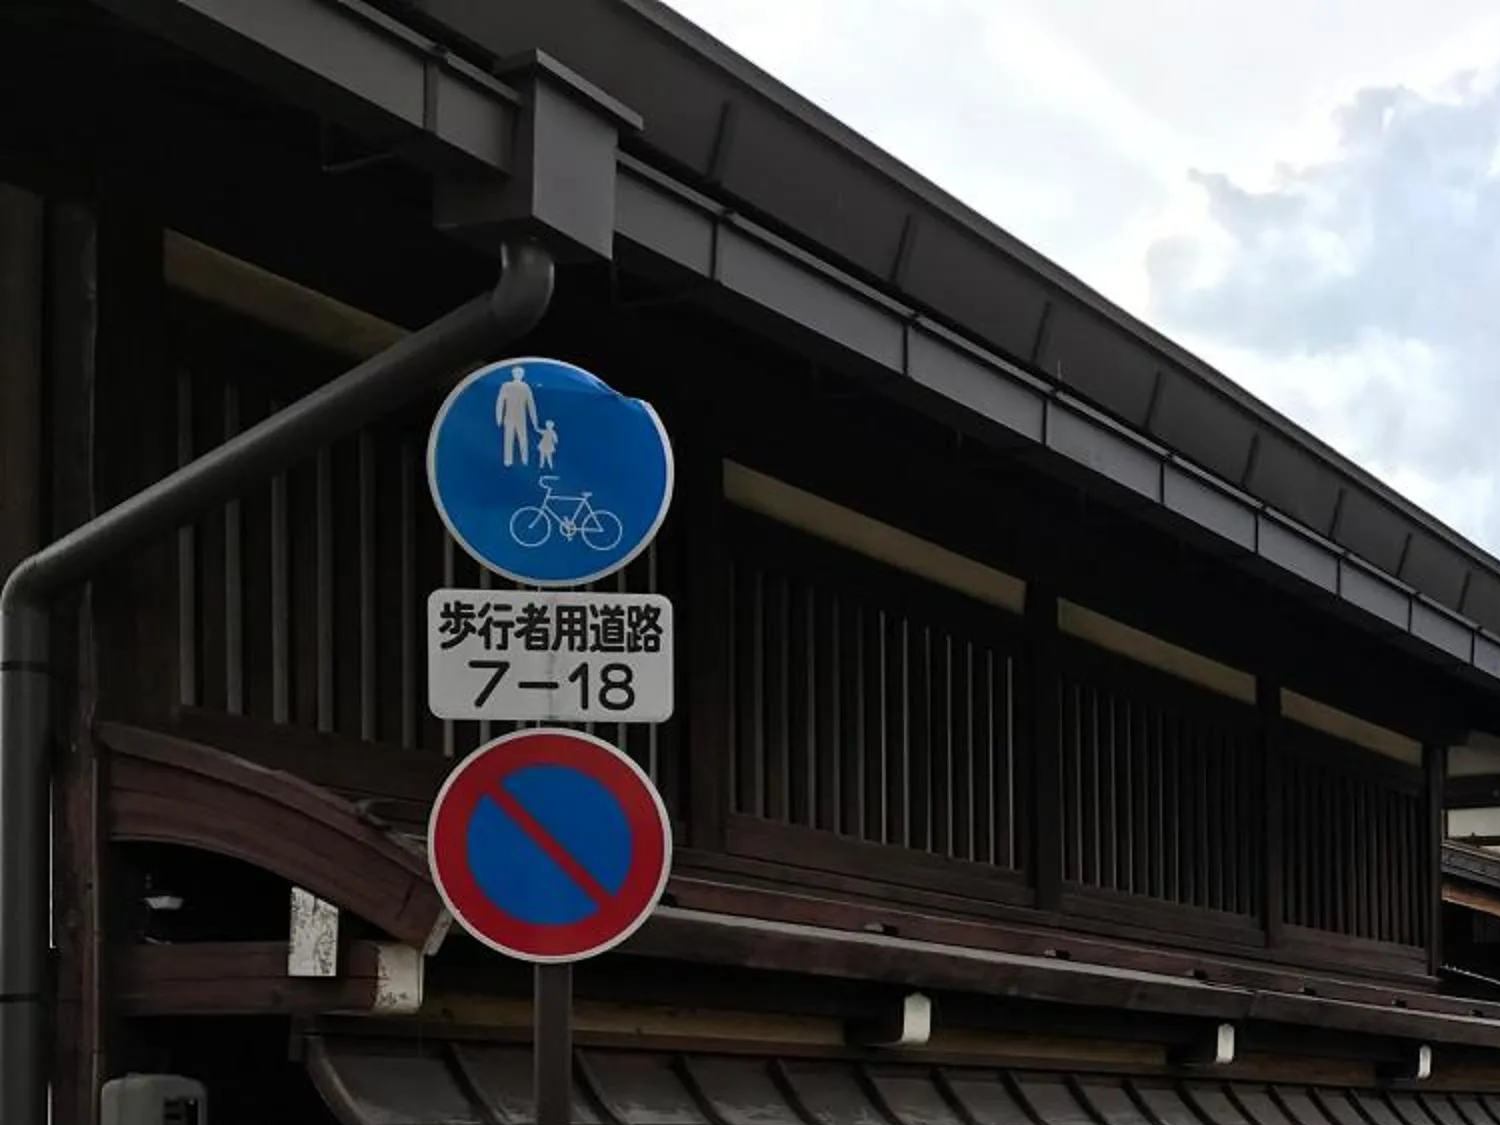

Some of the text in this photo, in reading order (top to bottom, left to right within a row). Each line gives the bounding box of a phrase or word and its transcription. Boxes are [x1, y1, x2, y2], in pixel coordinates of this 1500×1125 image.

[438, 601, 663, 652] 歩行者用道路
